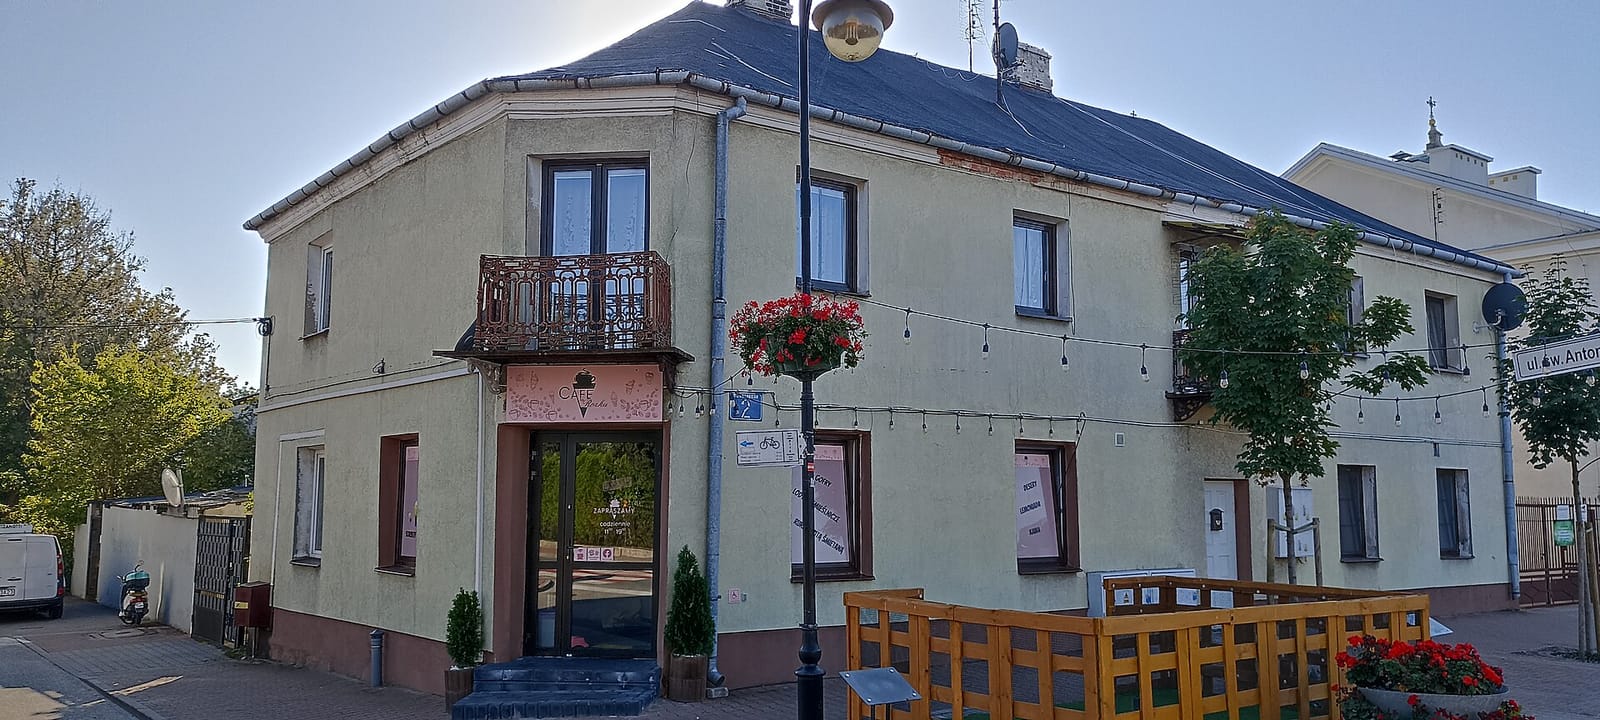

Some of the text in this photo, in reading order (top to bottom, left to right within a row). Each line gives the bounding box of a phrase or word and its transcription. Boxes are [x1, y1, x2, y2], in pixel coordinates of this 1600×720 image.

[1527, 357, 1541, 370] ul.
[1543, 355, 1564, 367] w.
[559, 386, 594, 400] CAFE
[740, 399, 750, 418] 2
[815, 474, 831, 487] GOFRY
[792, 488, 803, 498] LOD
[593, 506, 634, 514] ZAPRASZAMY
